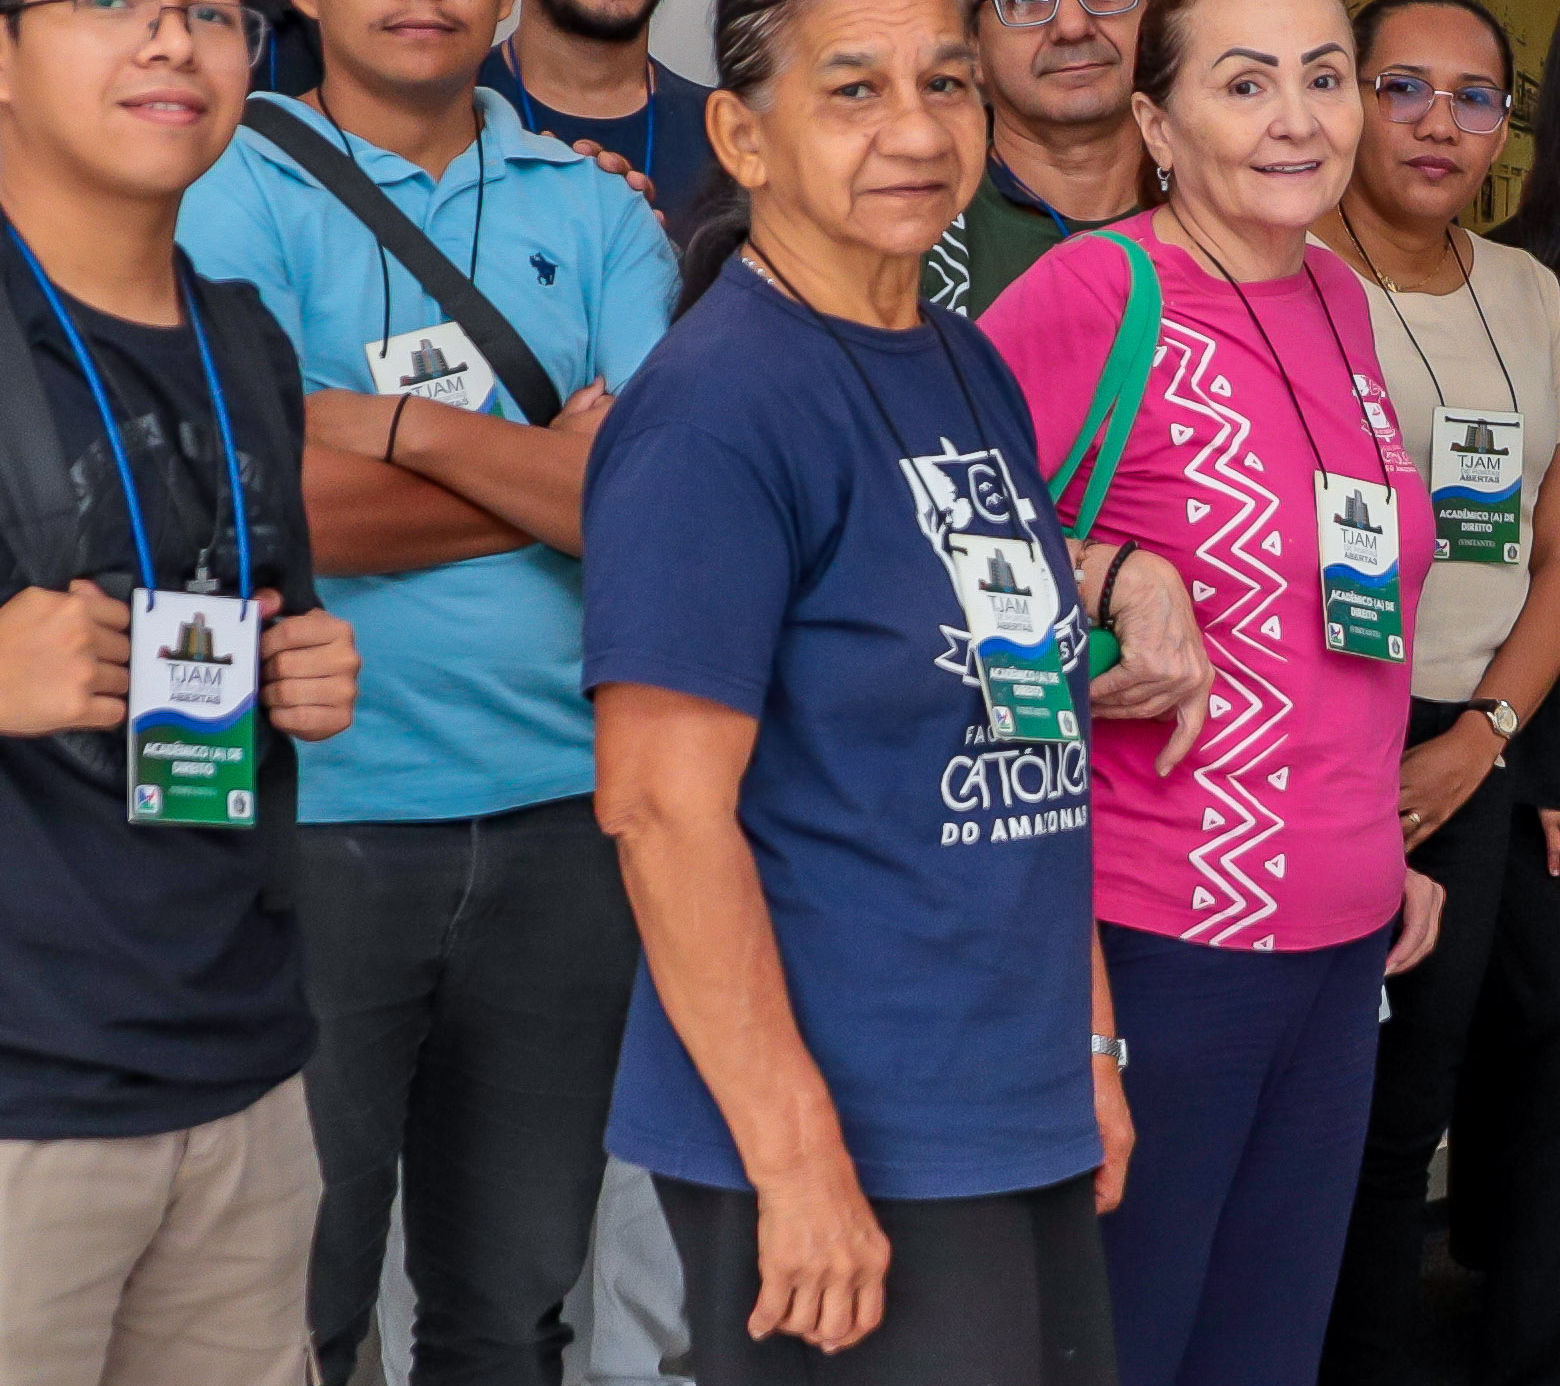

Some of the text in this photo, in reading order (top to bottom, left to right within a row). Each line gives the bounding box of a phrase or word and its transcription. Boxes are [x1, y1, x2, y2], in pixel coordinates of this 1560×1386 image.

[1457, 455, 1500, 470] TJAM
[1459, 474, 1500, 483] ABERTAS
[1461, 522, 1492, 533] DIREITO
[1340, 528, 1377, 550] TJAM
[988, 595, 1030, 615] TJAM
[168, 663, 222, 685] TJAM
[941, 740, 1088, 812] CATÓLICA
[941, 821, 981, 847] DO
